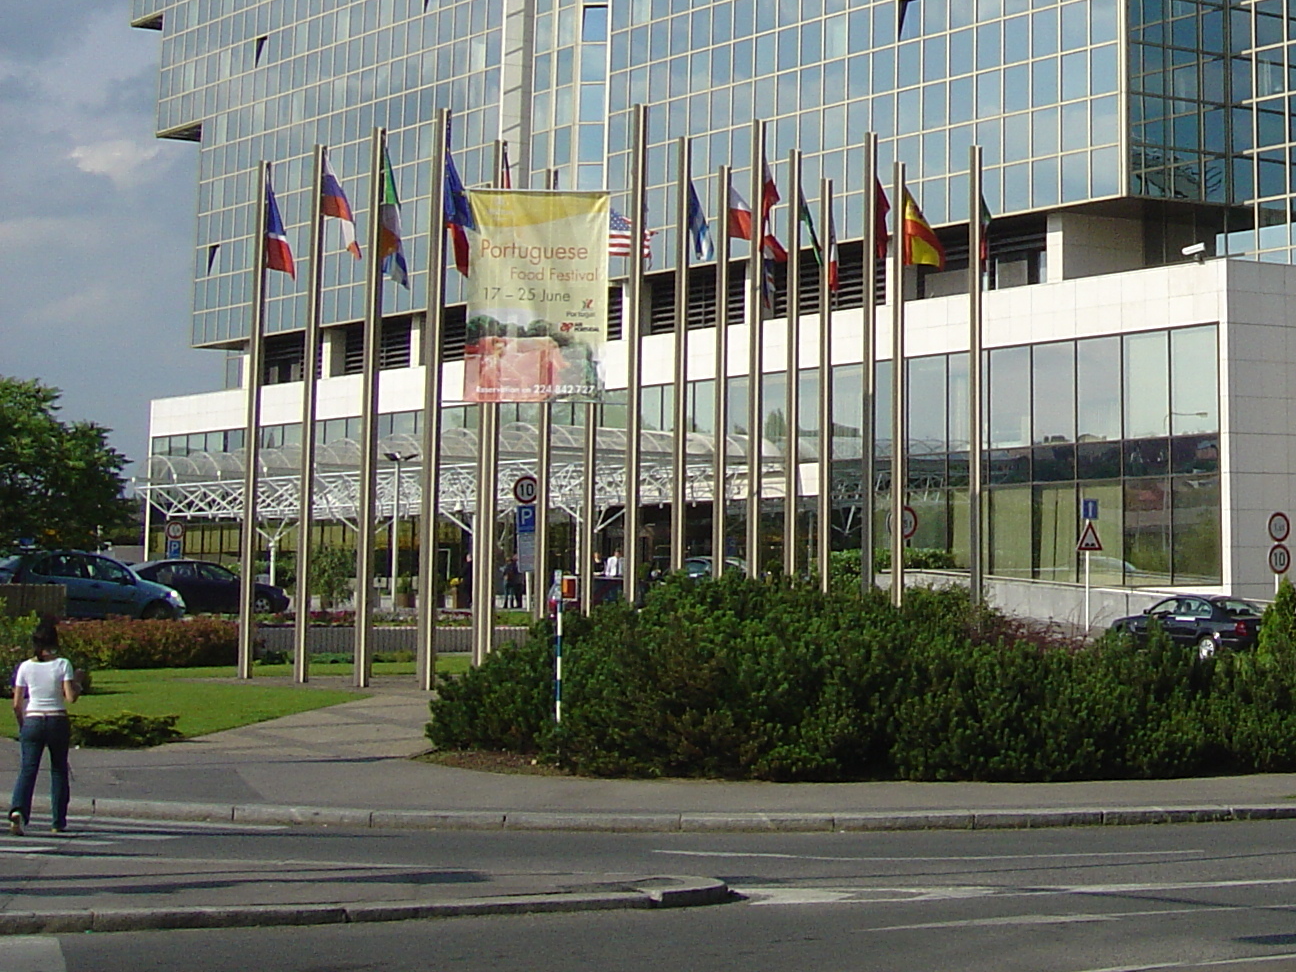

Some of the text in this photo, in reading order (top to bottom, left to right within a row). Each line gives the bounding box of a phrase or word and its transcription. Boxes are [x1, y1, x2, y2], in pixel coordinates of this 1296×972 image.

[481, 239, 588, 265] Portuguese
[510, 267, 599, 282] Food Festival
[483, 287, 501, 300] 17
[518, 287, 536, 301] 25
[540, 289, 571, 303] June
[476, 385, 518, 394] Reservation
[533, 384, 552, 394] 224
[555, 384, 574, 395] 842
[576, 384, 596, 394] 727
[520, 483, 534, 497] 10
[521, 508, 533, 525] P
[1273, 551, 1286, 567] 10
